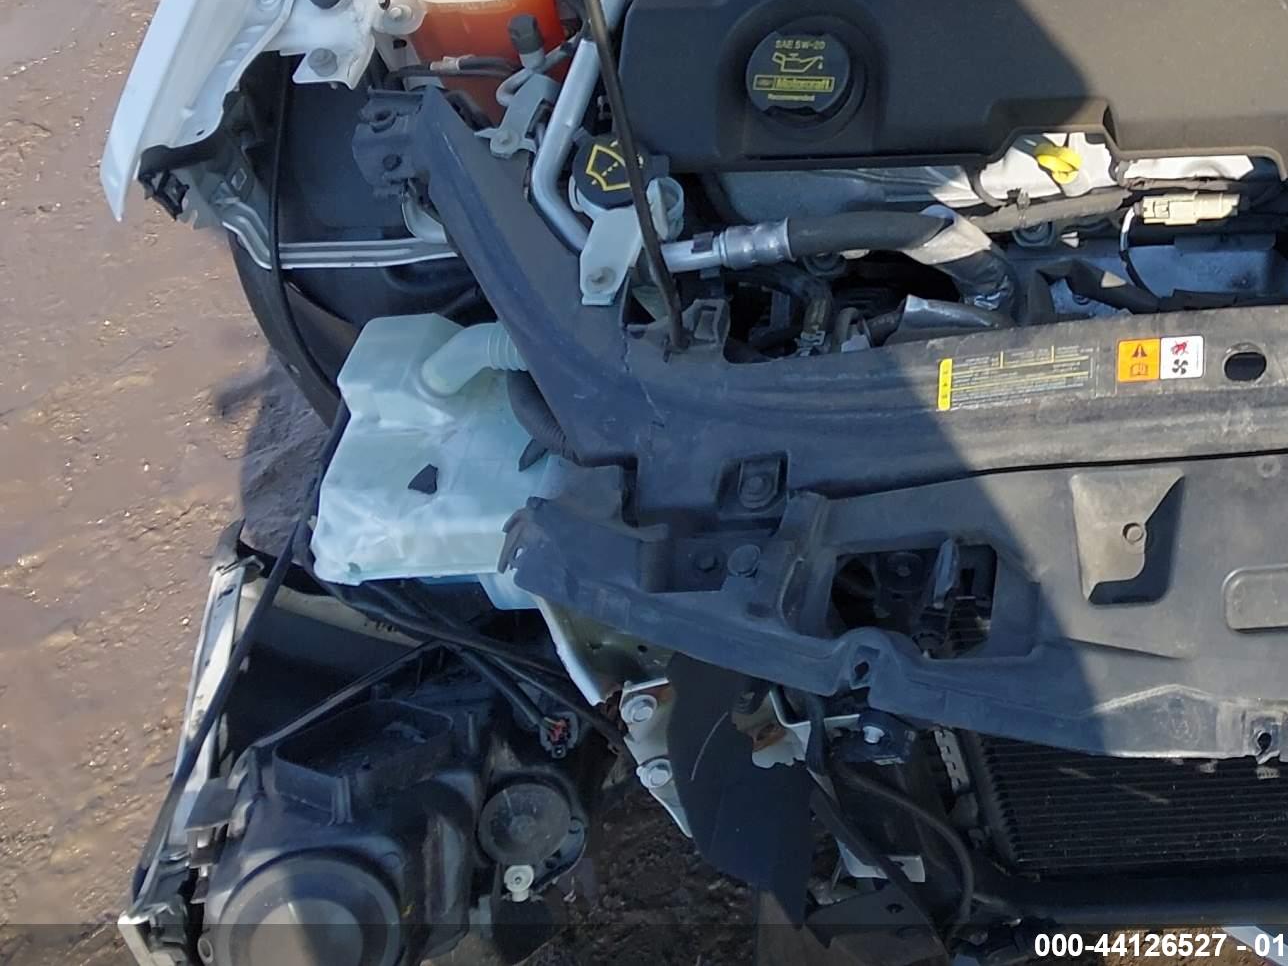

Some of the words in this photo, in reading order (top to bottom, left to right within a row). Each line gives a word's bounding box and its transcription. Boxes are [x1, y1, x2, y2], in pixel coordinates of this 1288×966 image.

[775, 39, 793, 50] SAE
[795, 39, 826, 50] 5W-20
[775, 77, 829, 90] Motorcraft
